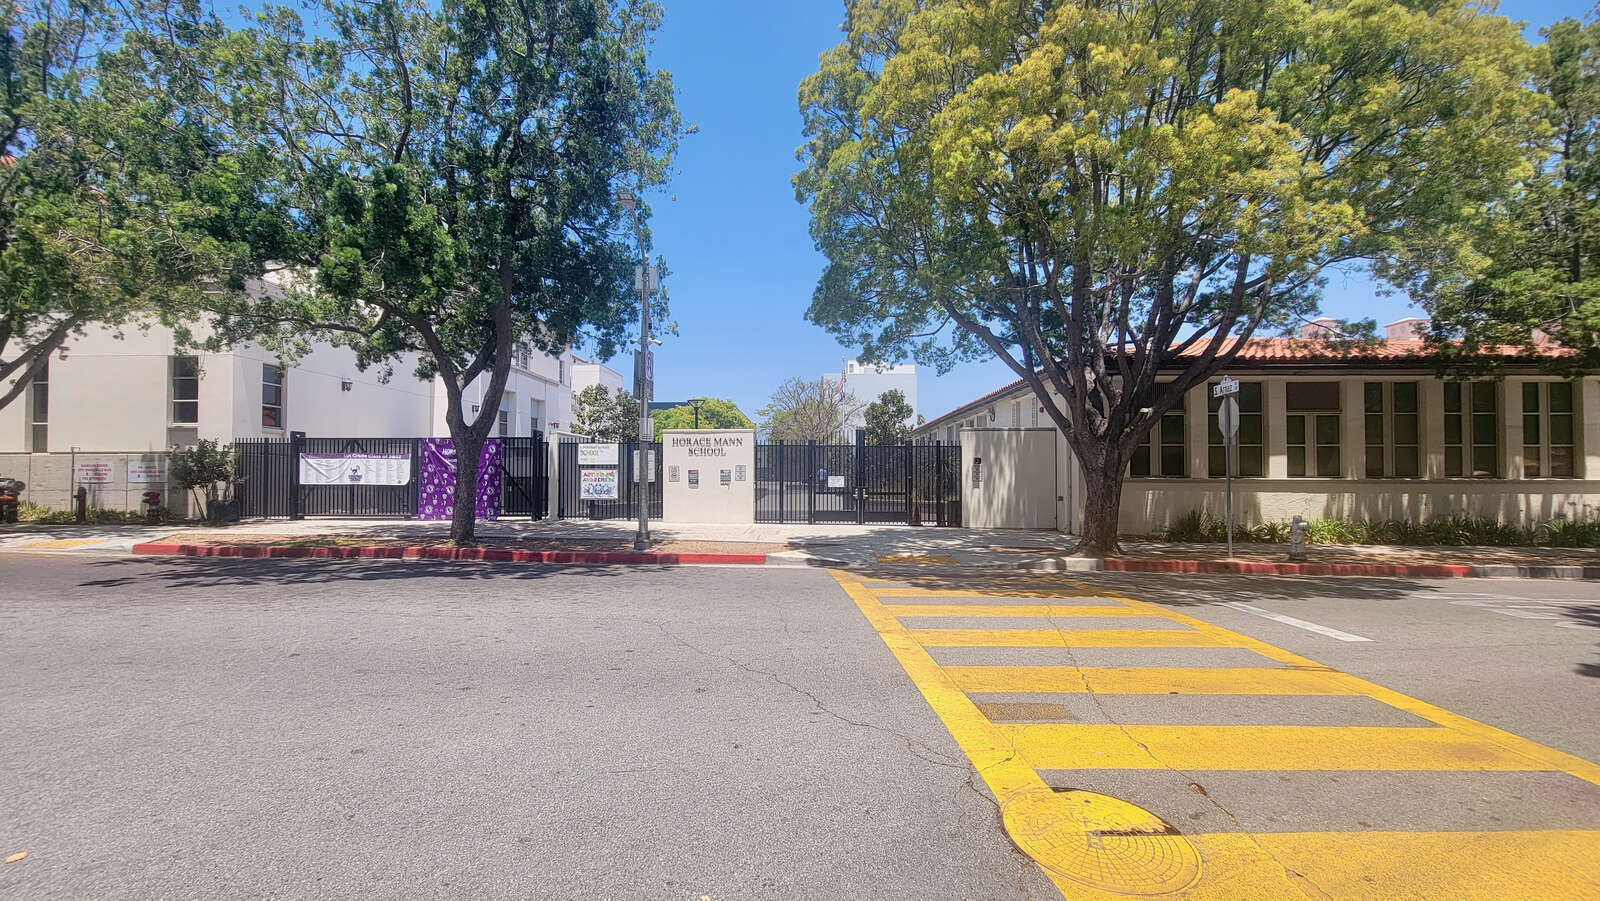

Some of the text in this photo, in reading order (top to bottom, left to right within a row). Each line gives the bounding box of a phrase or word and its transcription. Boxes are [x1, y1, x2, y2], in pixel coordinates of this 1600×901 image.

[671, 437, 744, 447] HORACE MANN
[688, 447, 727, 457] SCHOOL
